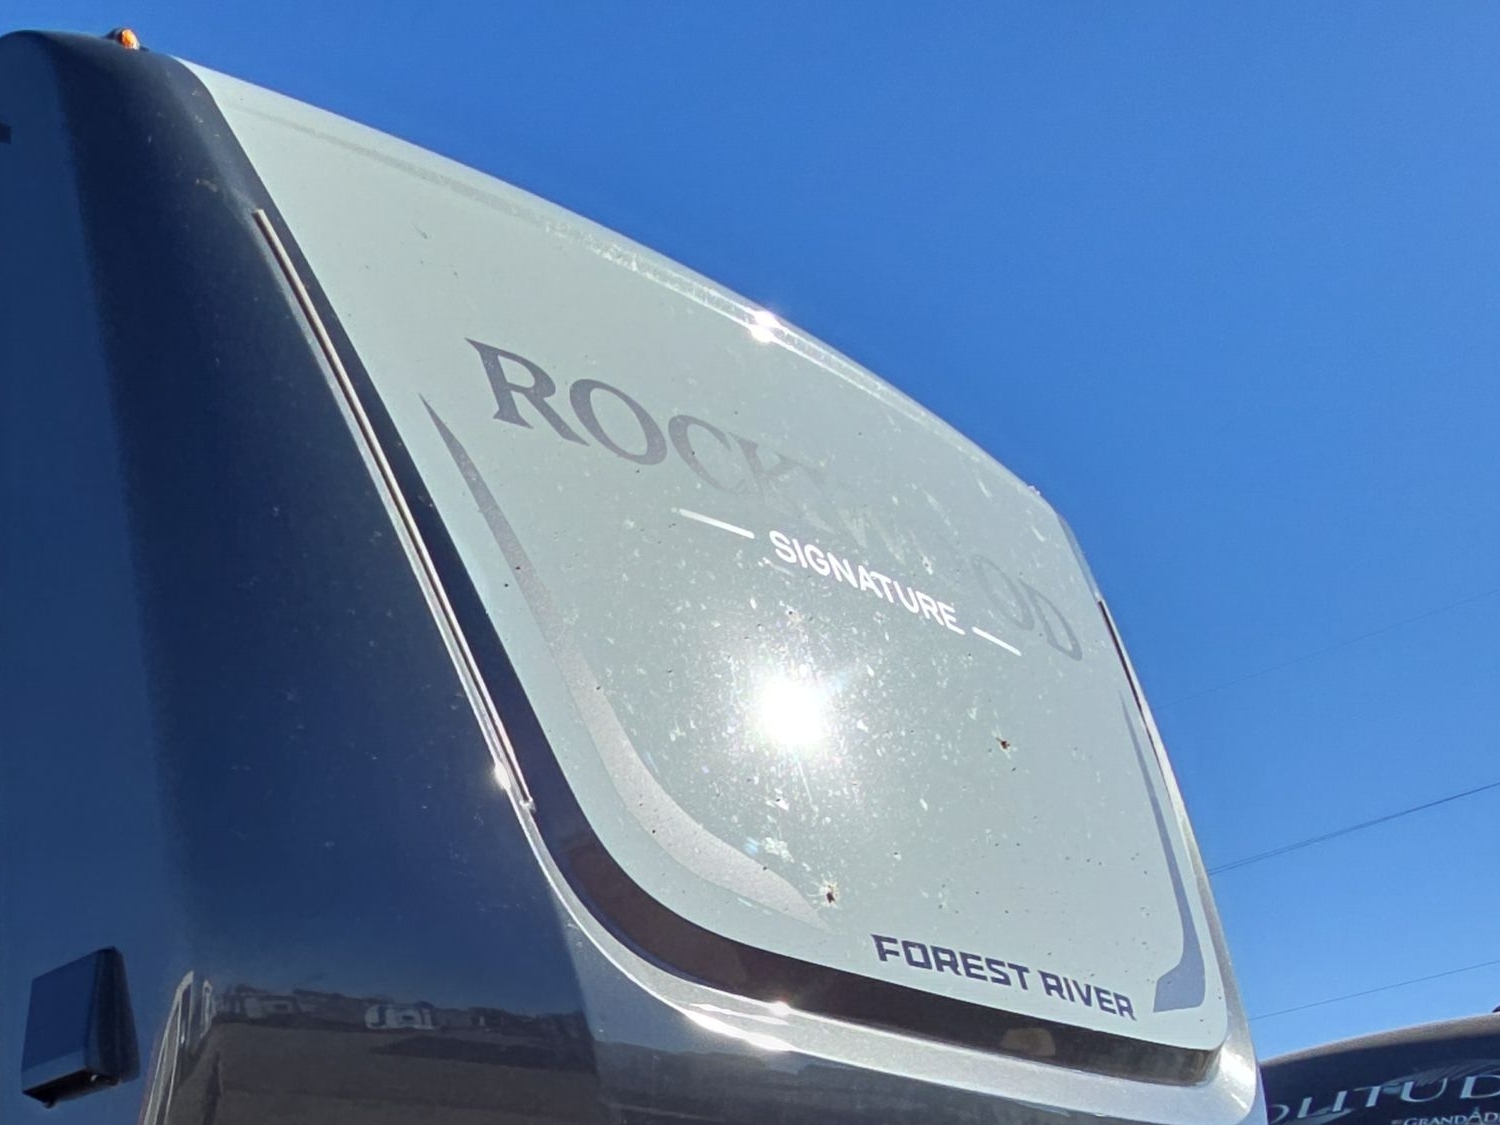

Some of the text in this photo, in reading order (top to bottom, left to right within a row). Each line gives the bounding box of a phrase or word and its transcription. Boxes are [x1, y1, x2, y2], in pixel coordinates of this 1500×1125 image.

[769, 530, 965, 635] SIGNATURE
[871, 934, 1137, 1021] FOREST RIVER
